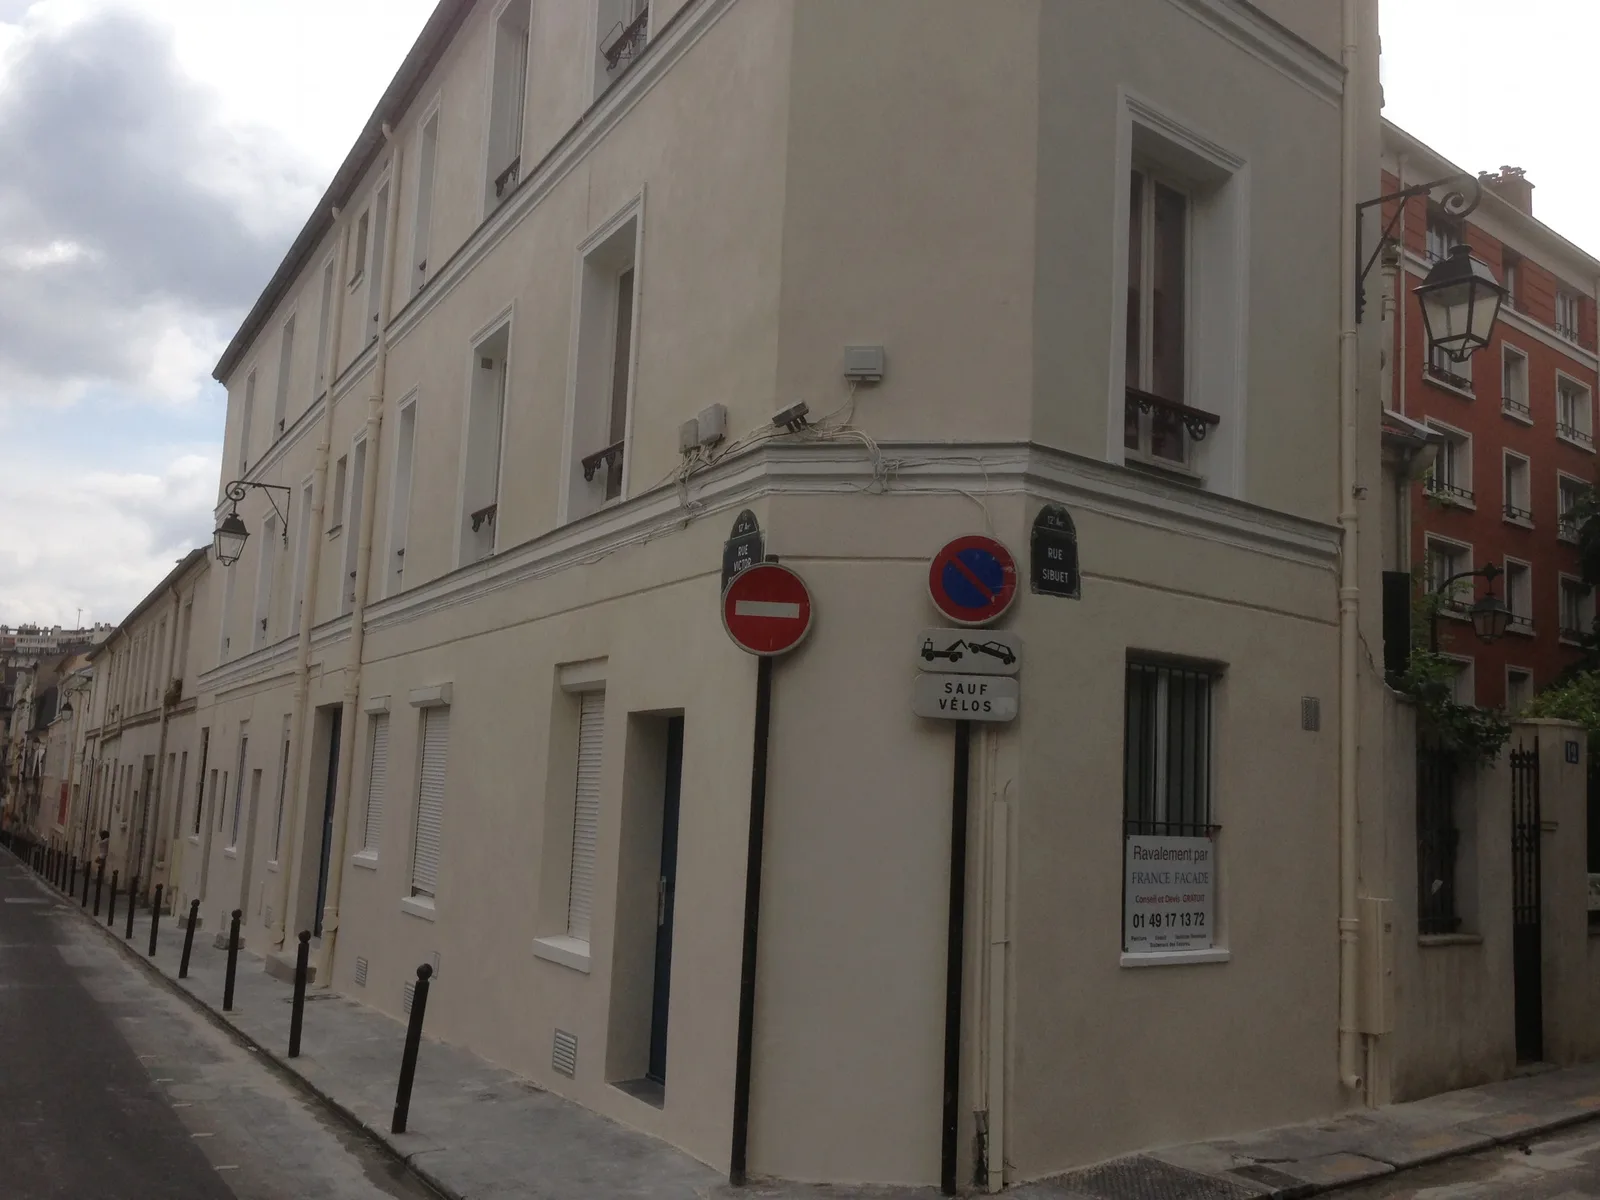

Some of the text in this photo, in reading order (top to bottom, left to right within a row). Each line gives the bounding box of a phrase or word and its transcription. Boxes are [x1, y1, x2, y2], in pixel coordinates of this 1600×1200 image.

[738, 544, 748, 557] RUE
[1047, 547, 1063, 561] RUE
[1042, 568, 1069, 584] SIBUET
[944, 682, 988, 695] SAUF
[939, 696, 992, 712] VÉLOS
[1133, 845, 1209, 864] Ravalement par
[1132, 871, 1171, 884] FRANCE
[1135, 894, 1205, 904] Conseil et Devis GRATUIT
[1132, 911, 1205, 928] 01 49 17 13 72
